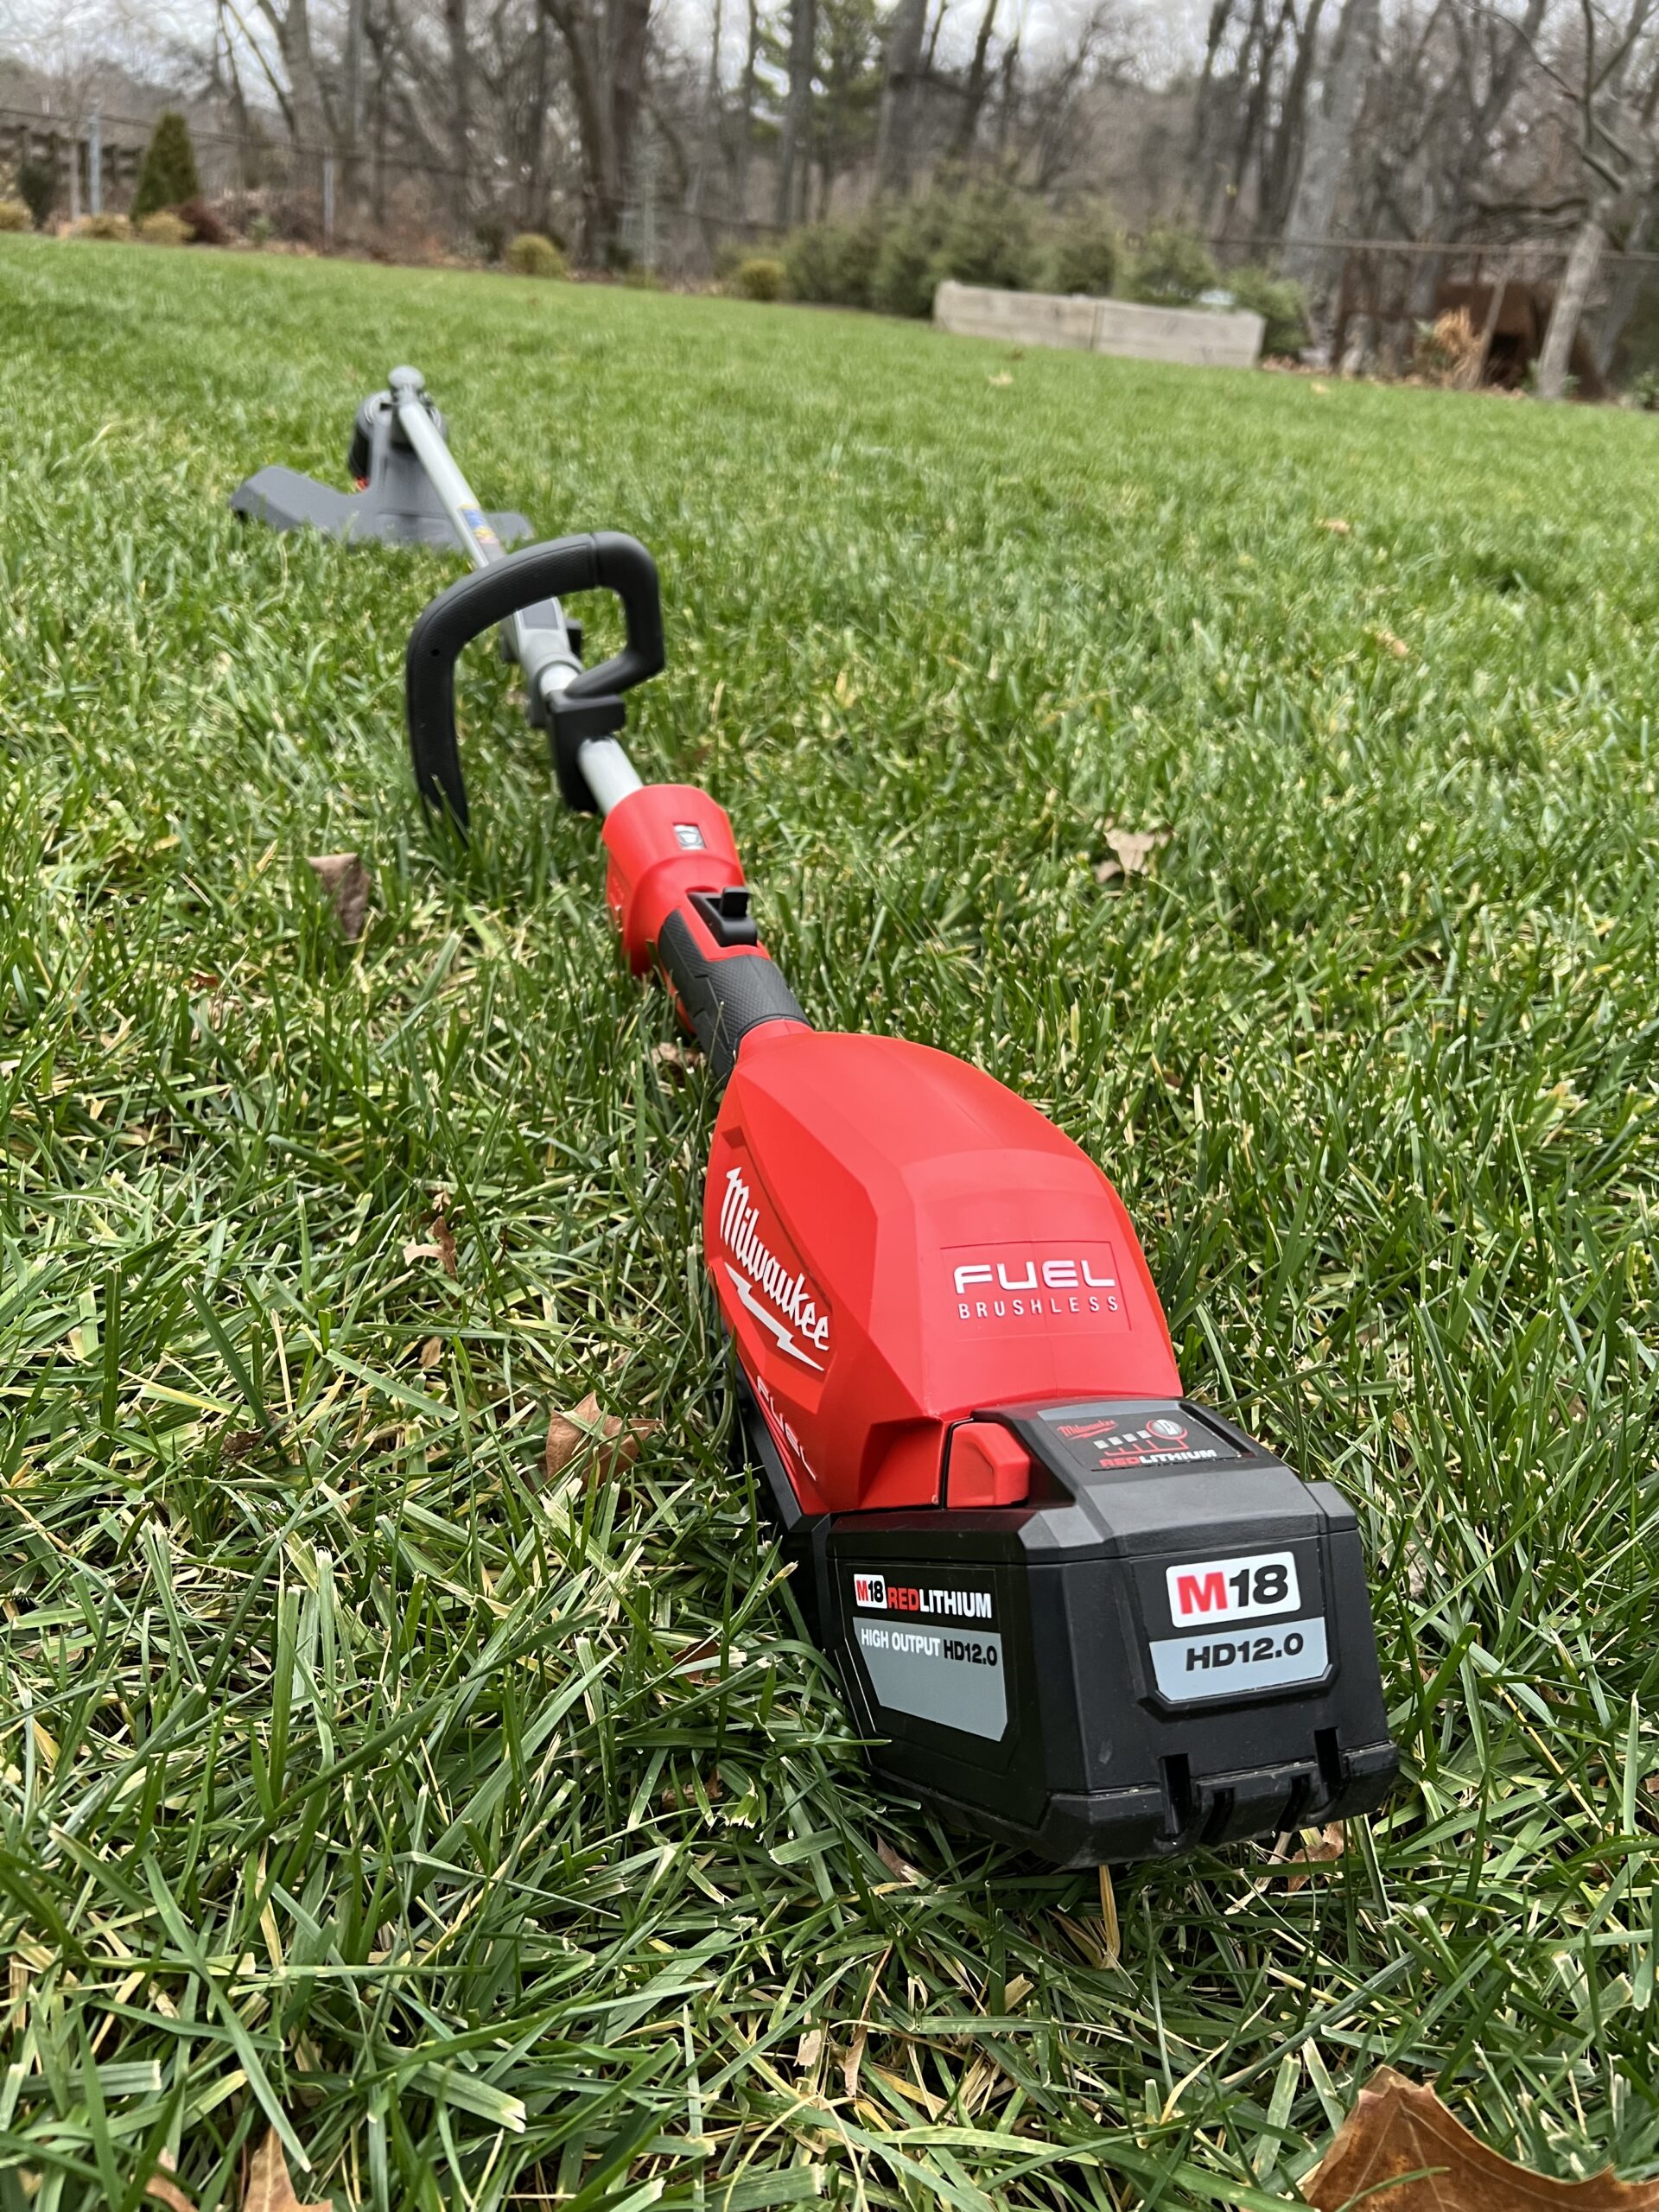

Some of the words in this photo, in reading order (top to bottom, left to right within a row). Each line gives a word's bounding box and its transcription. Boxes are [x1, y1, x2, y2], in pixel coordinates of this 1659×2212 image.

[720, 1166, 830, 1351] Milwaukee
[953, 1260, 1116, 1294] FUEL
[958, 1296, 1118, 1319] BRUSHLESS
[757, 1375, 817, 1481] FUEL
[1057, 1419, 1116, 1438] Milwaukee
[1099, 1449, 1217, 1468] REDLITHIUM
[856, 1580, 884, 1603] M18
[887, 1586, 993, 1618] REDLITHIUM
[1176, 1564, 1288, 1615] M18
[861, 1628, 889, 1649] HIGH
[892, 1631, 941, 1656] OUTPUT
[944, 1639, 998, 1666] HD12.0
[1185, 1633, 1304, 1672] HD12.0
